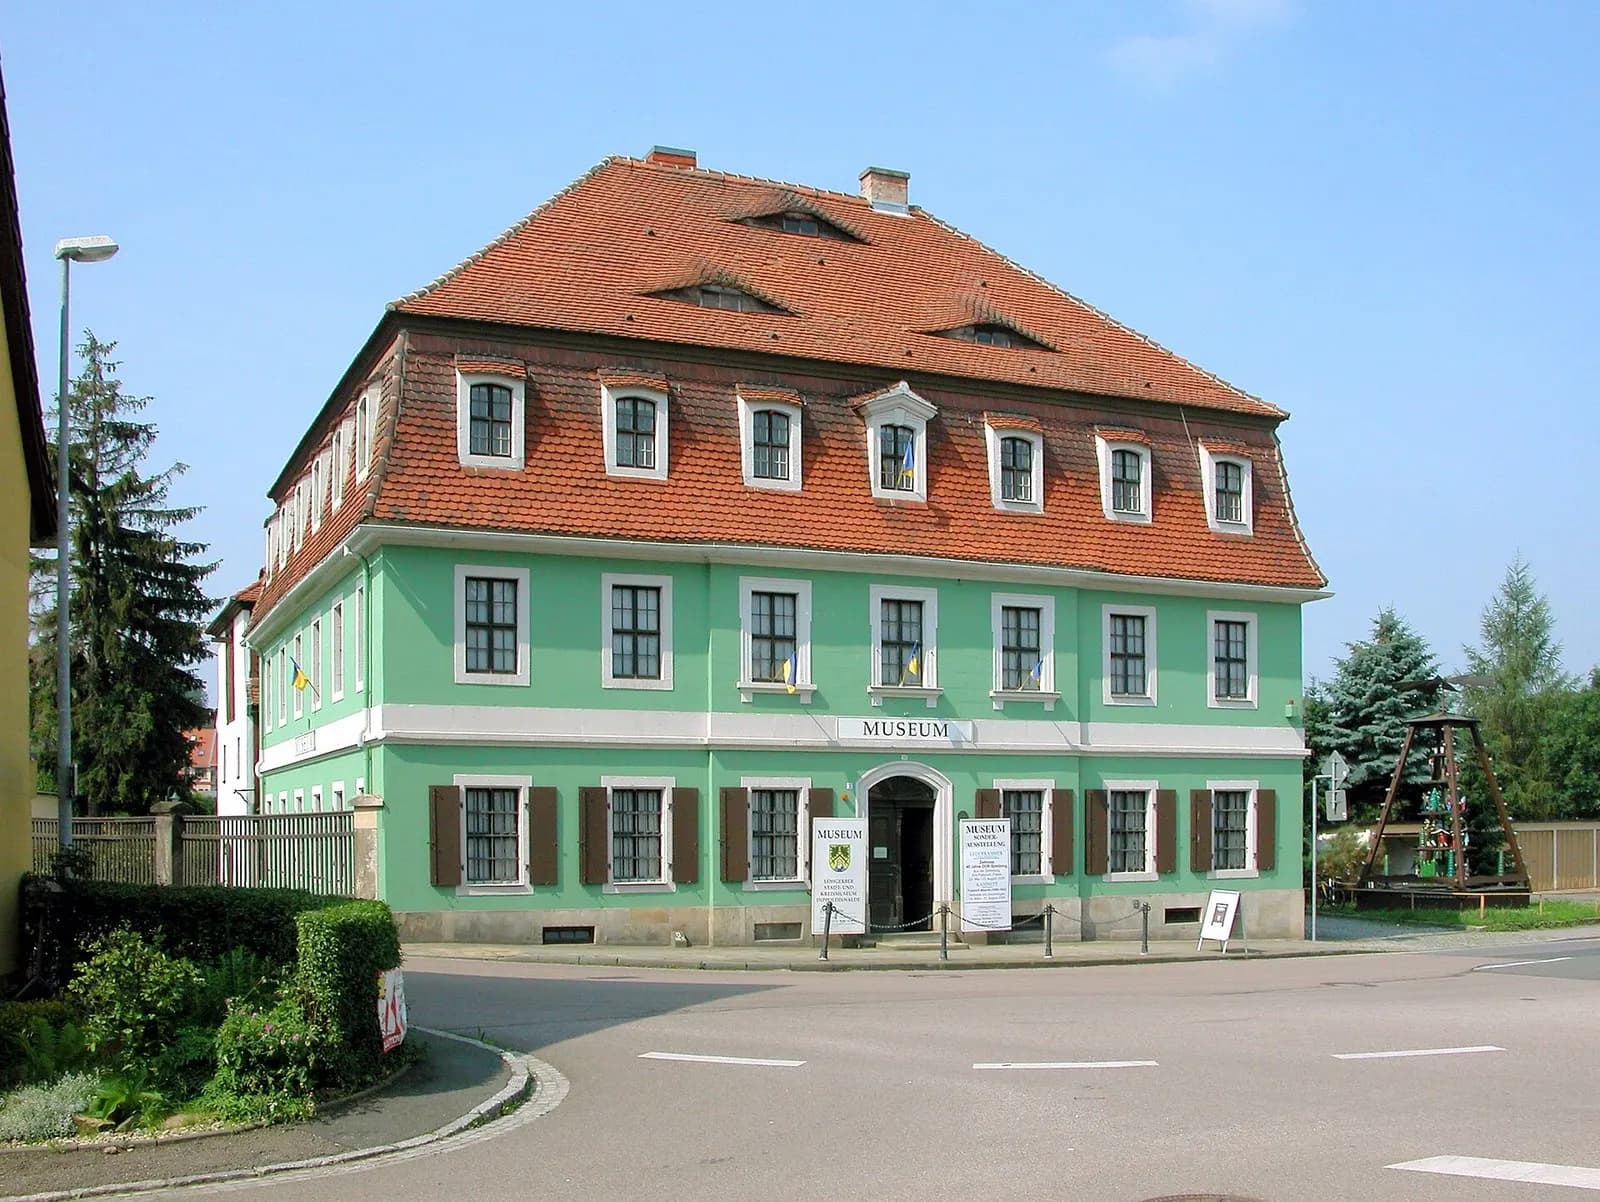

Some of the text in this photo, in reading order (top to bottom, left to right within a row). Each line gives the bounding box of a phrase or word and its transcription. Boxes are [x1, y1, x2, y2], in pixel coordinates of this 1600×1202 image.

[863, 721, 949, 737] MUSEUM
[966, 824, 1005, 833] MUSEUM
[817, 829, 862, 839] MUSEUM
